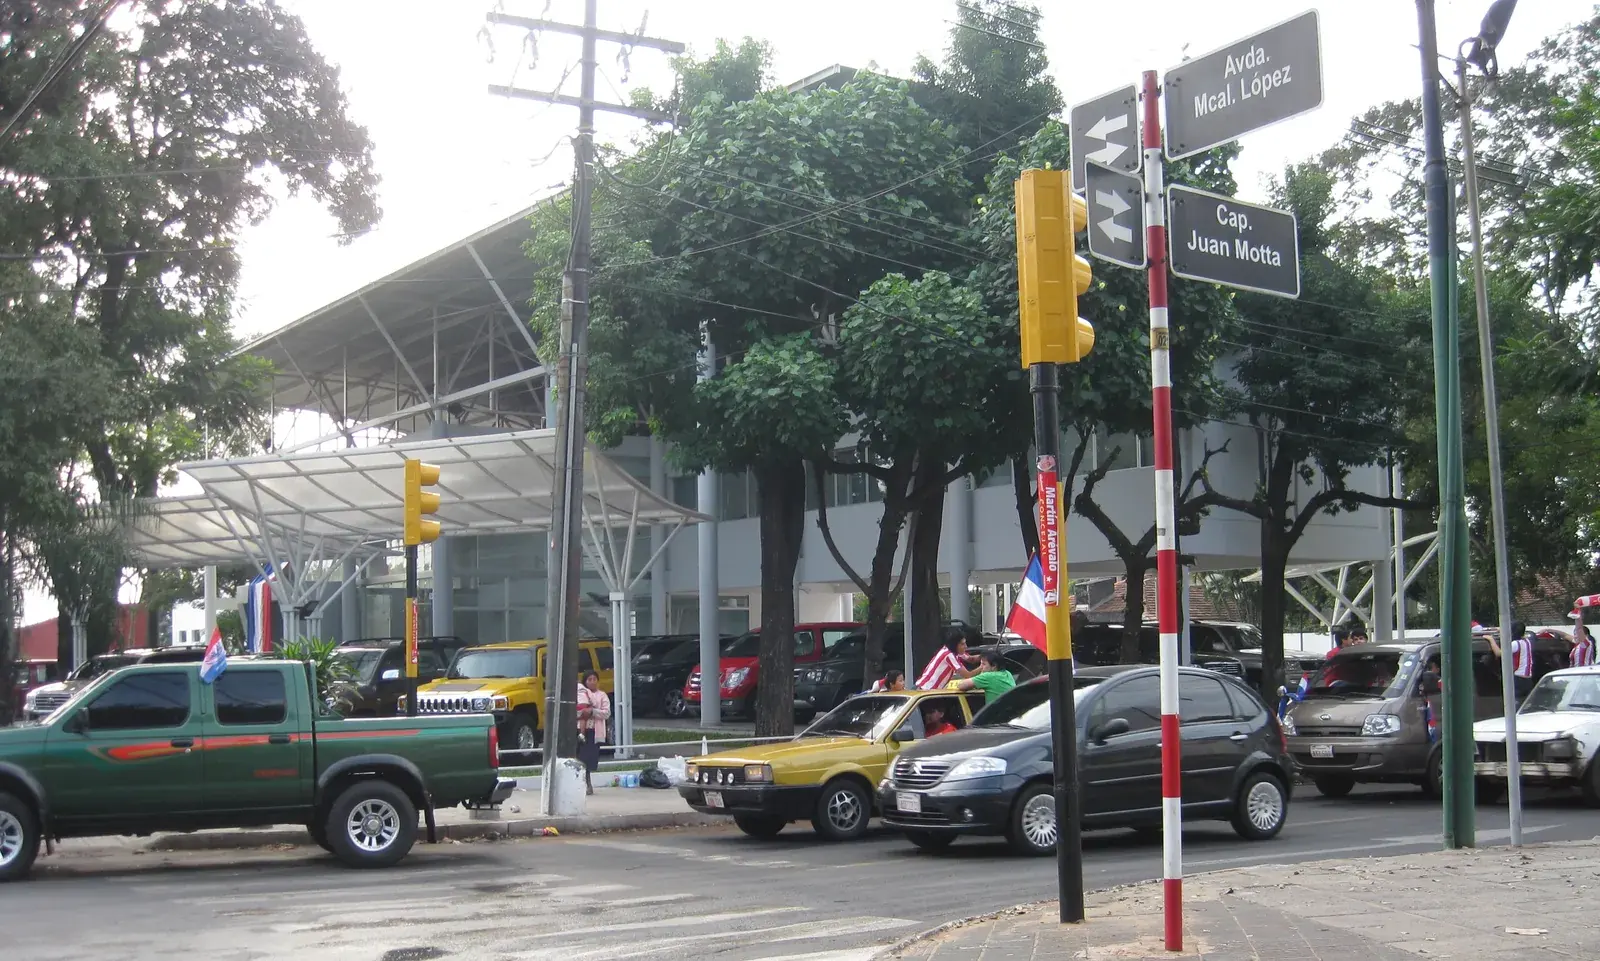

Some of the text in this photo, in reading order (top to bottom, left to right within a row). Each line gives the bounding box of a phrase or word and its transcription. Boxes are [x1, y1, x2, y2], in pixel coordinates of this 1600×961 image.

[1224, 45, 1270, 79] Avda.
[1194, 65, 1292, 118] Mcal. López
[1216, 204, 1253, 233] Cap.
[1187, 230, 1281, 266] Juan Motta
[1045, 487, 1058, 571] Martín Arévalo
